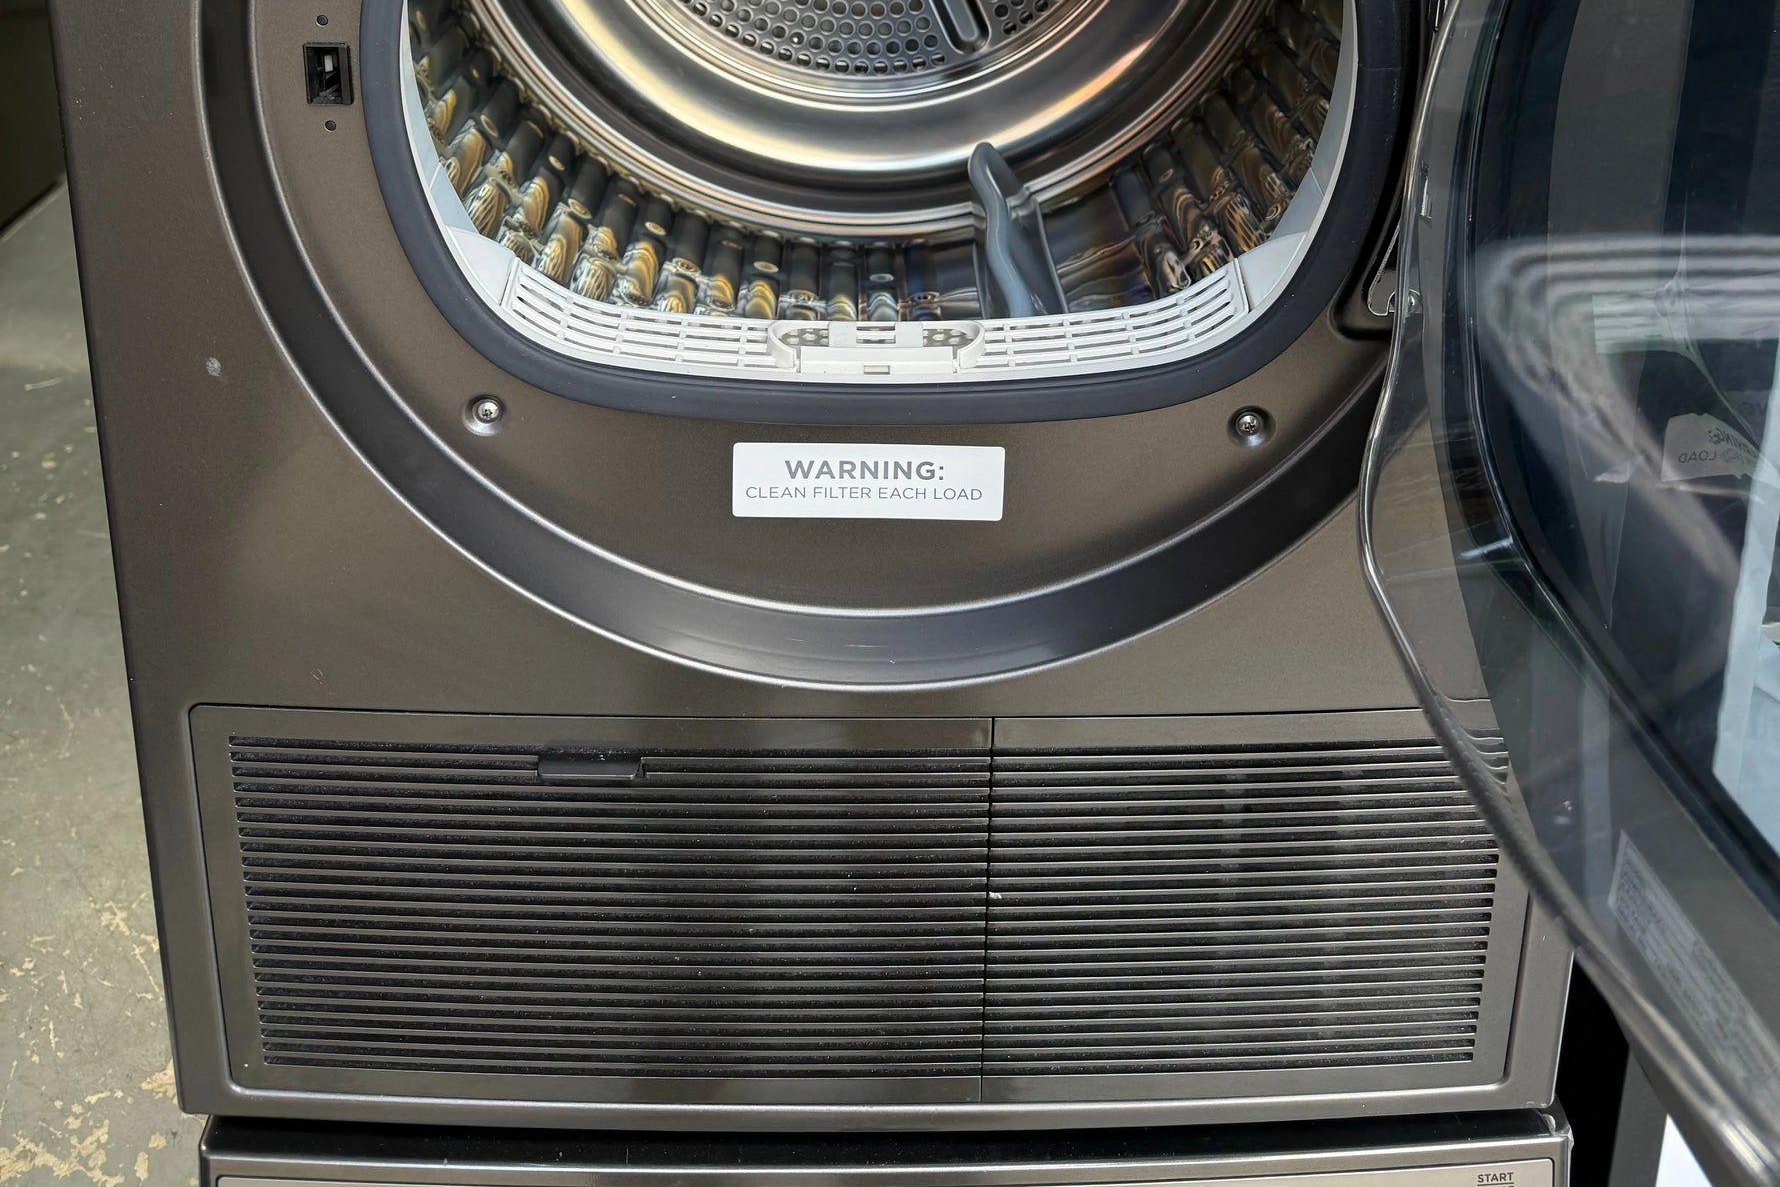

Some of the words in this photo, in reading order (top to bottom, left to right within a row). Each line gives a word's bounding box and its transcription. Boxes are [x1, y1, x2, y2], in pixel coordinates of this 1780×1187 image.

[785, 460, 944, 480] WARNING:
[746, 486, 806, 499] CLEAN
[813, 487, 871, 499] FILTER
[878, 488, 926, 500] EACH
[934, 488, 982, 500] LOAD
[1477, 1172, 1514, 1183] START
